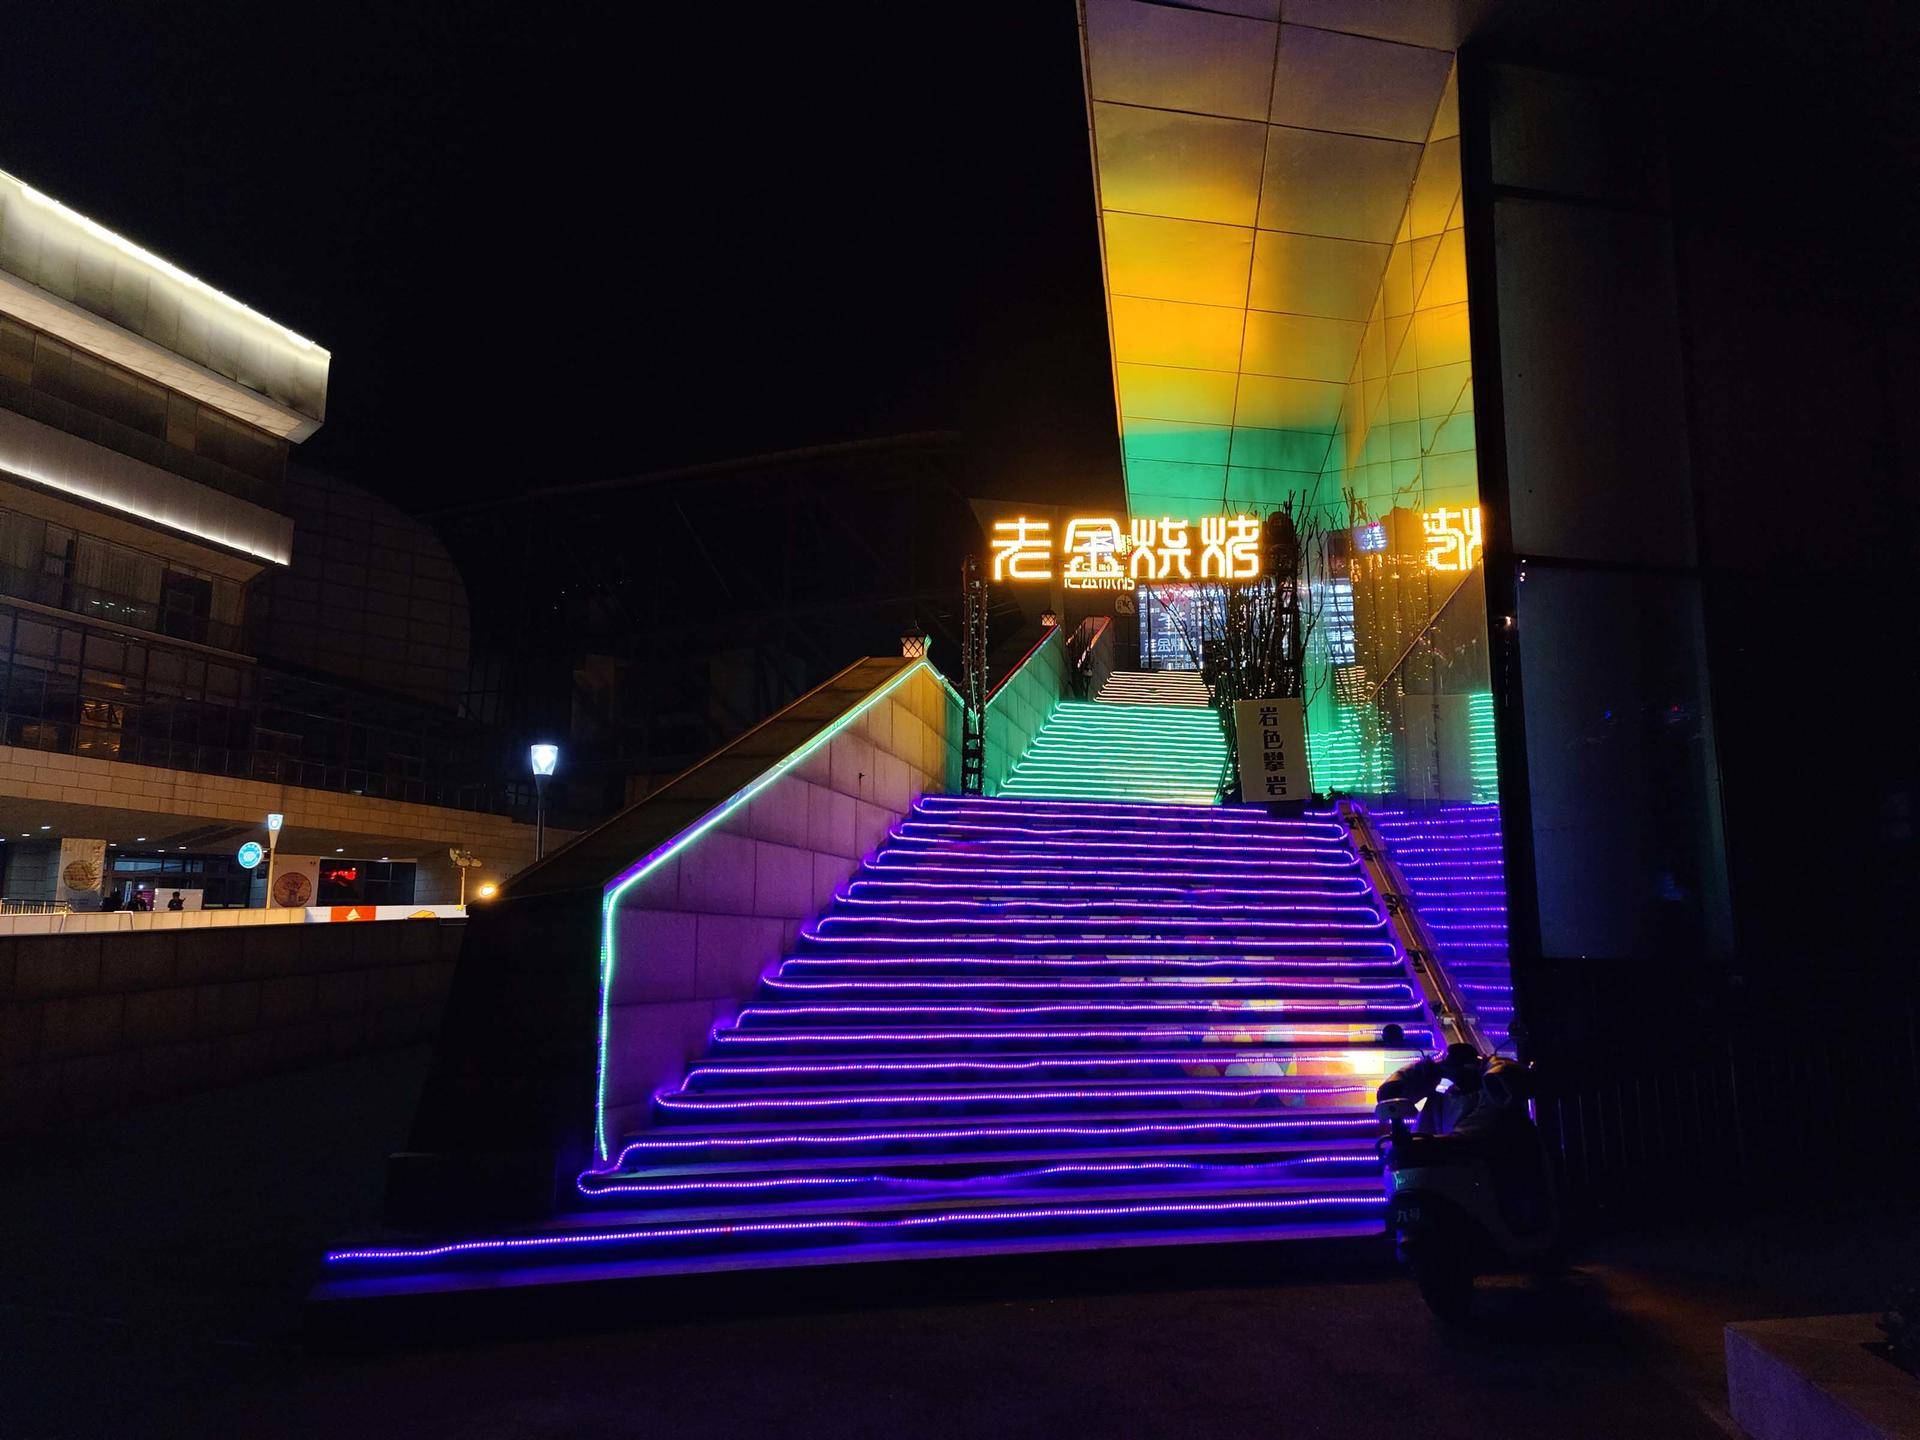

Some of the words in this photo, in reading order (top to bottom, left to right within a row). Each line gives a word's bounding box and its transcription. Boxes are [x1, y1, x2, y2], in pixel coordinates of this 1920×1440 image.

[991, 516, 1261, 580] 老金烧烤
[1258, 706, 1288, 796] 岩色攀岩
